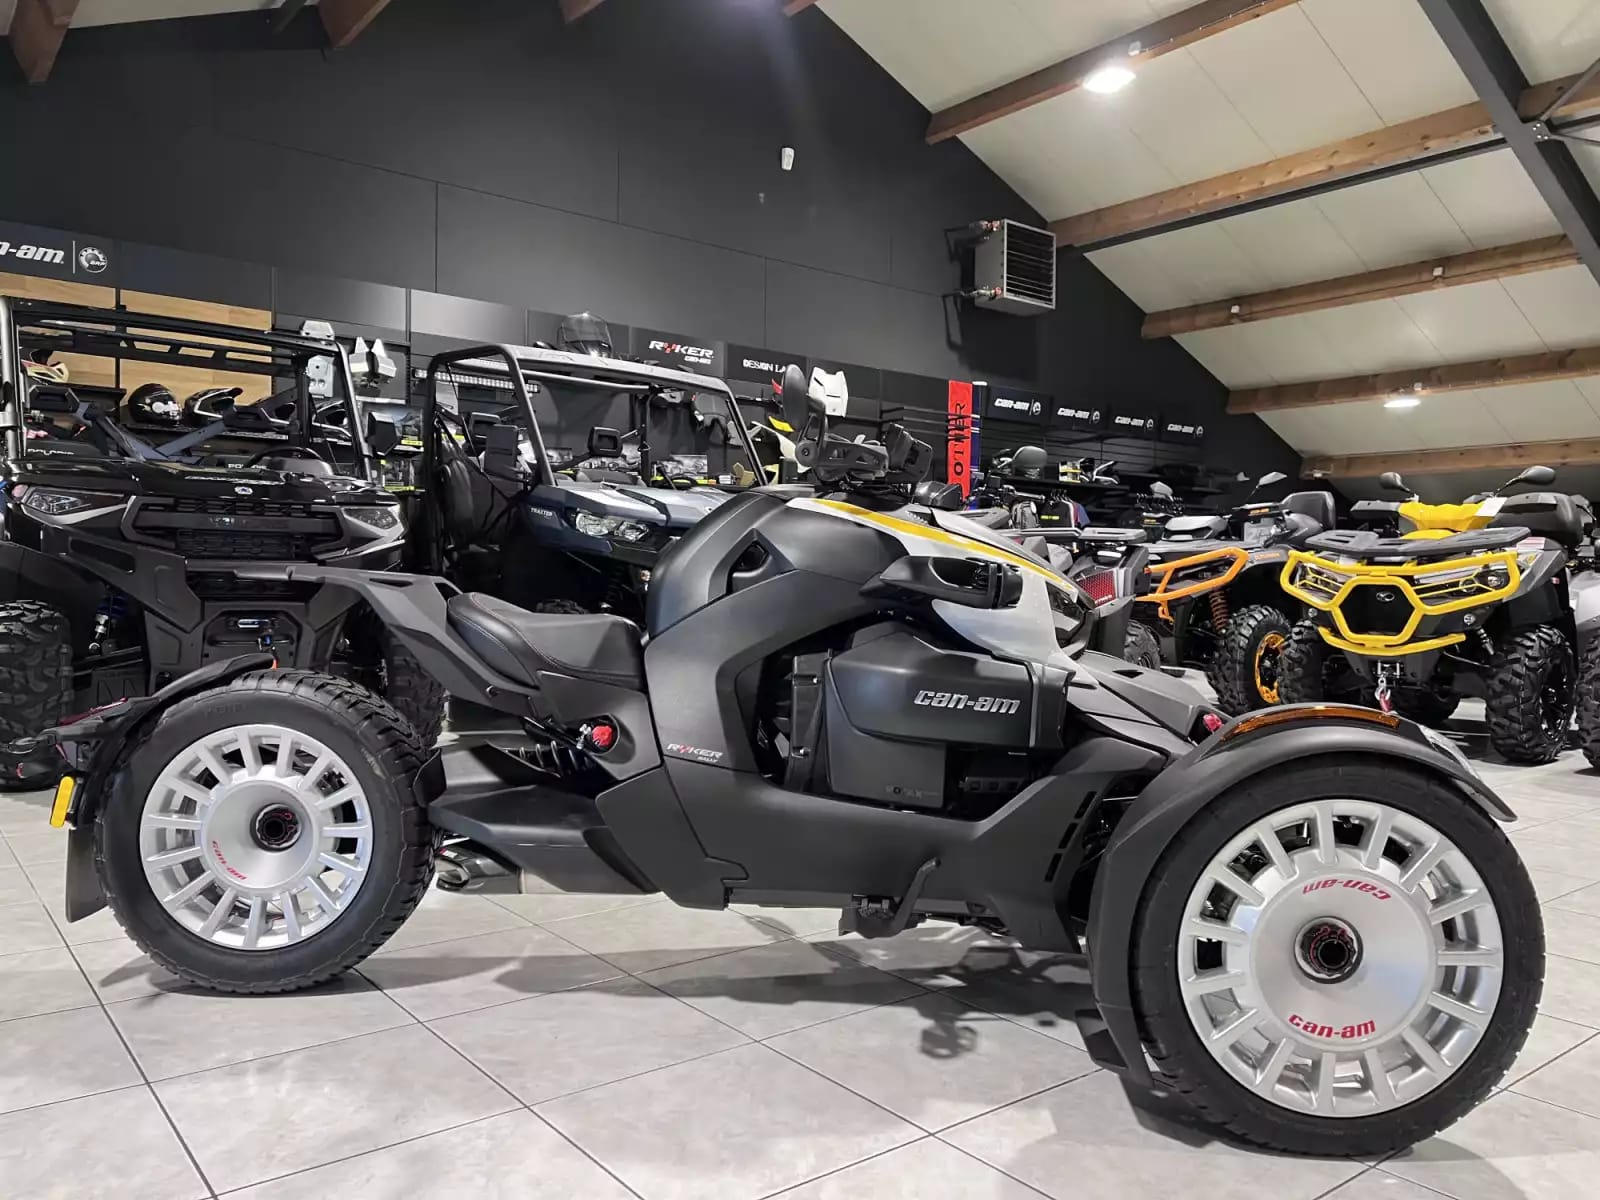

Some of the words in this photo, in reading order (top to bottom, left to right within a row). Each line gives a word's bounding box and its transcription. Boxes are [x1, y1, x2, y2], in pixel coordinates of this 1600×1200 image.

[649, 341, 714, 358] RYKER
[742, 358, 774, 372] DESIGN
[914, 690, 1021, 714] can-am
[667, 743, 723, 758] RYKER
[1302, 878, 1391, 900] can-am
[1288, 1014, 1376, 1039] can-am
